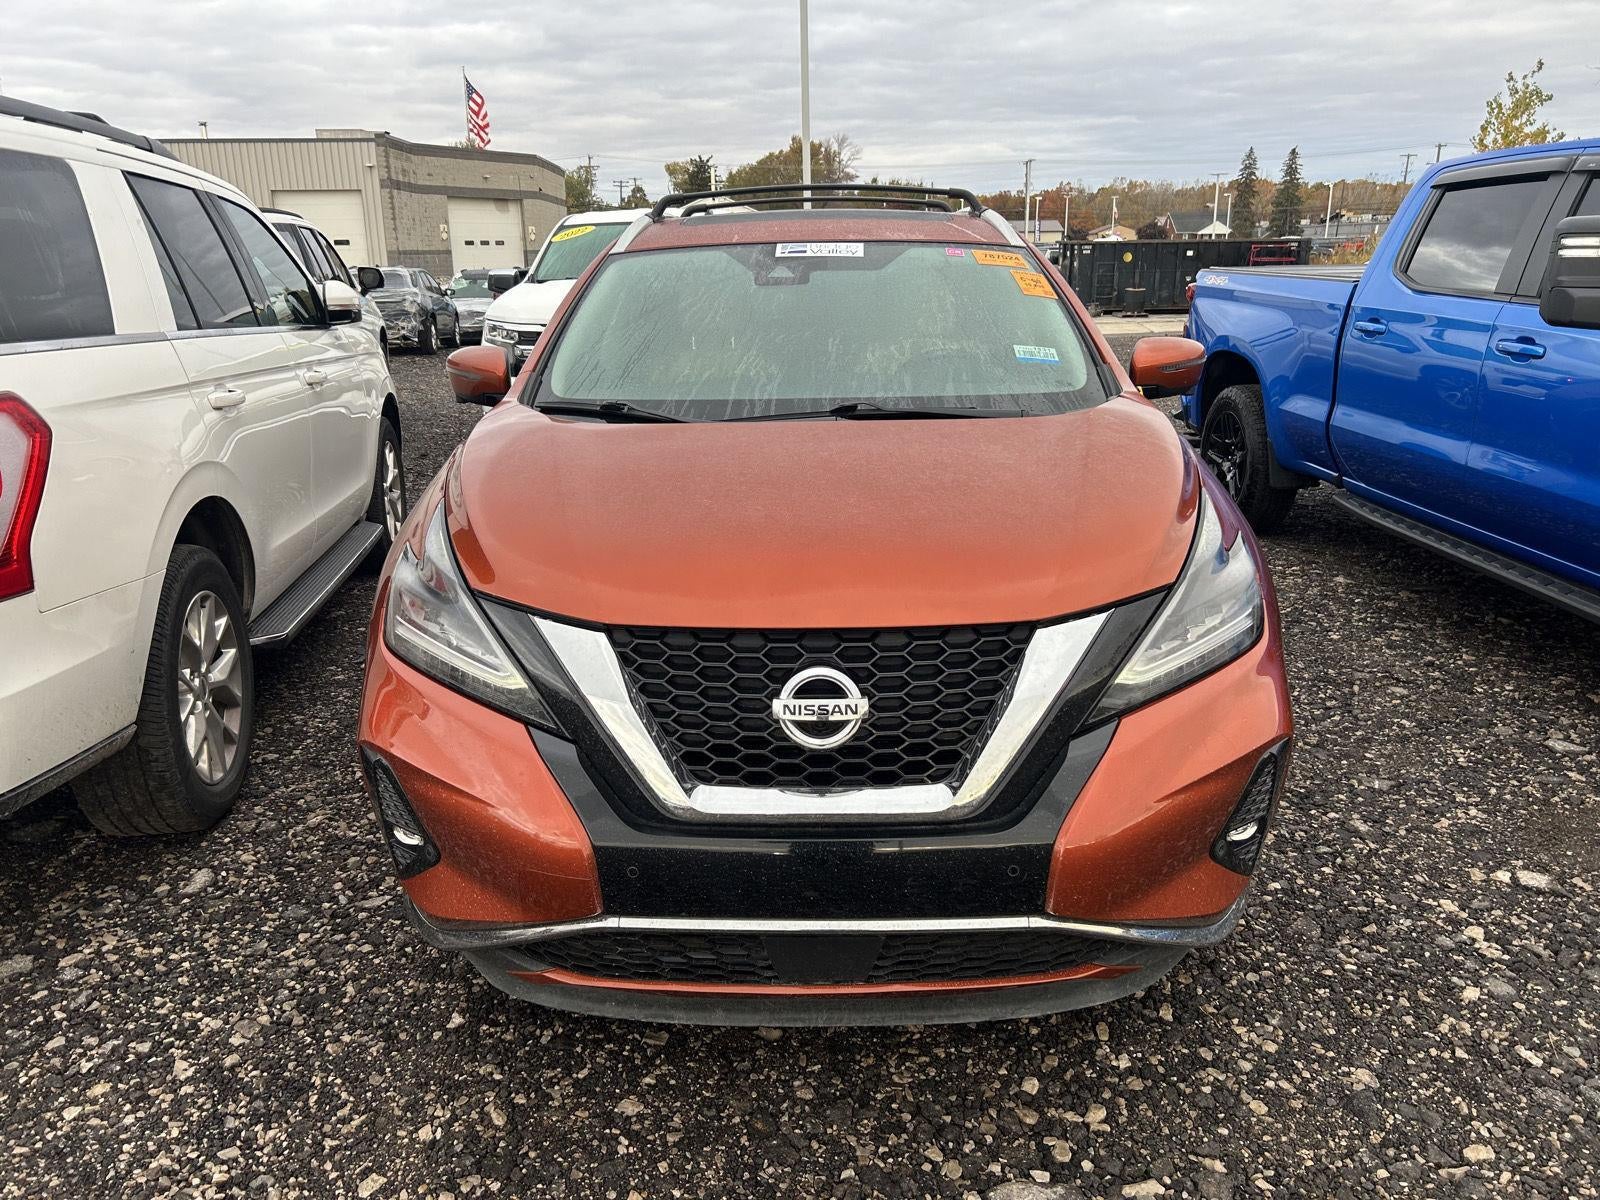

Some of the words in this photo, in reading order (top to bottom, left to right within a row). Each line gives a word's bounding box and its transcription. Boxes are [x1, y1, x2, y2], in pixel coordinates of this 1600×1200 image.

[560, 227, 588, 240] 2022
[810, 248, 858, 256] Valley
[783, 704, 858, 716] NISSAN
